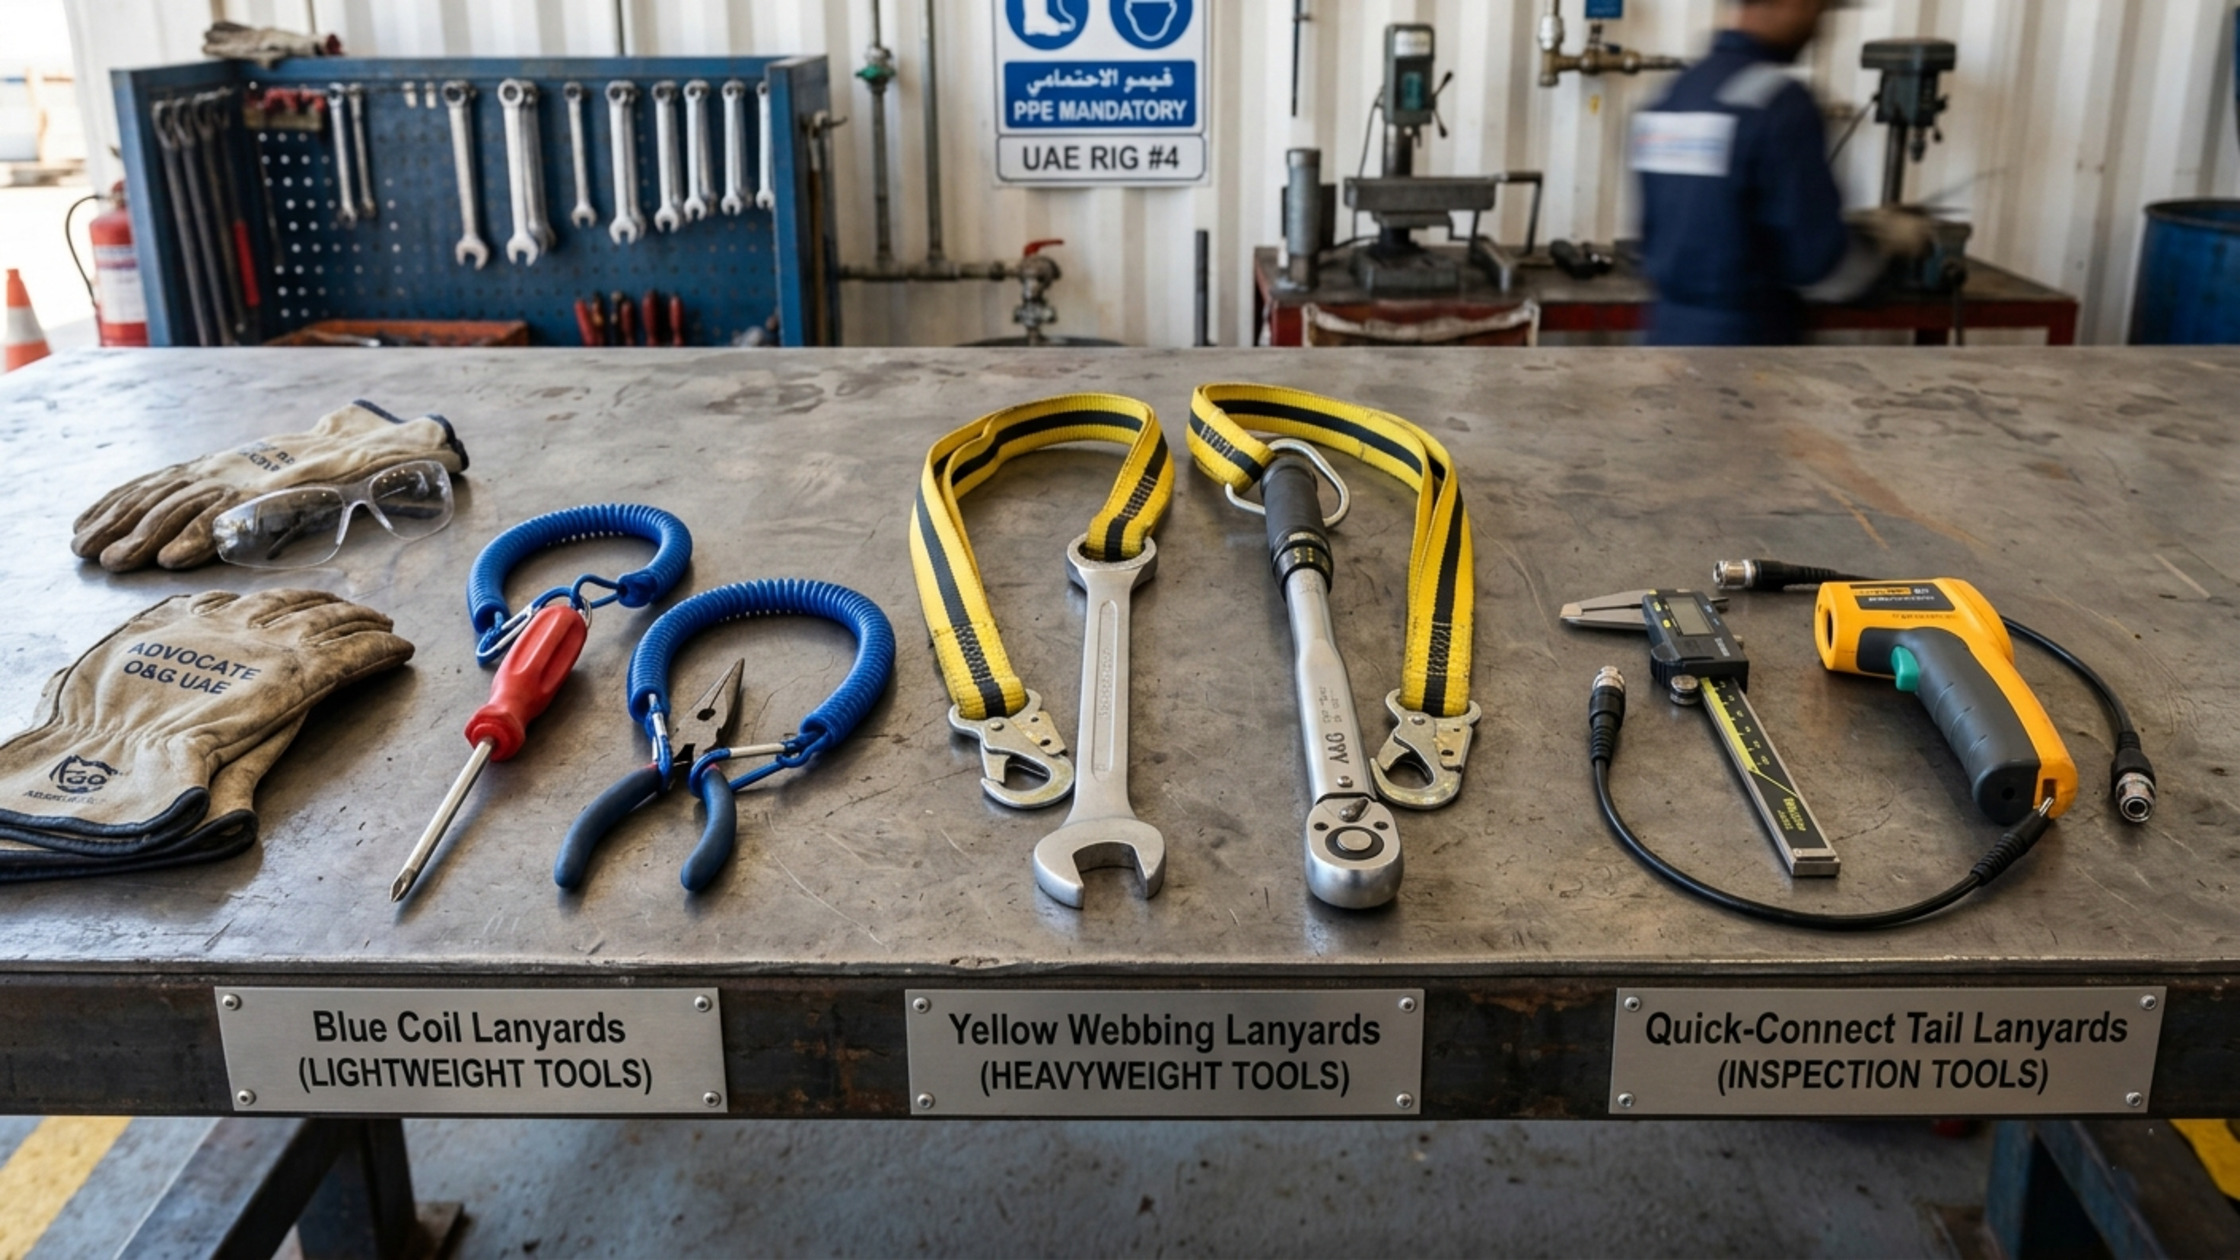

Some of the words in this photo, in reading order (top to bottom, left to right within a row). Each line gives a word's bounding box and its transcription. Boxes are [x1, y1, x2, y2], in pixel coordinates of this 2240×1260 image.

[1014, 99, 1054, 121] PPE
[1059, 99, 1187, 121] MANDATORY
[1022, 146, 1080, 171] UAE
[1090, 146, 1139, 171] RIG
[1148, 145, 1179, 170] #4
[124, 660, 177, 683] O&G
[179, 673, 231, 694] UAE
[127, 642, 261, 680] ADVOCATE
[313, 1011, 387, 1042] Blue
[398, 1011, 462, 1043] Coil
[472, 1012, 626, 1051] Lanyards
[949, 1013, 1058, 1045] Yellow
[1068, 1013, 1214, 1053] Webbing
[1227, 1013, 1380, 1053] Lanyards
[1646, 1012, 1895, 1046] Quick-Connect
[1907, 1012, 1963, 1044] Tail
[1974, 1011, 2128, 1051] Lanyards
[298, 1057, 525, 1094] (LIGHTWEIGHT
[534, 1058, 652, 1095] TOOLS)
[980, 1060, 1222, 1097] (HEAVYWEIGHT
[1232, 1060, 1350, 1098] TOOLS)
[1717, 1059, 1920, 1096] (INSPECTION
[1931, 1058, 2048, 1095] TOOLS)
